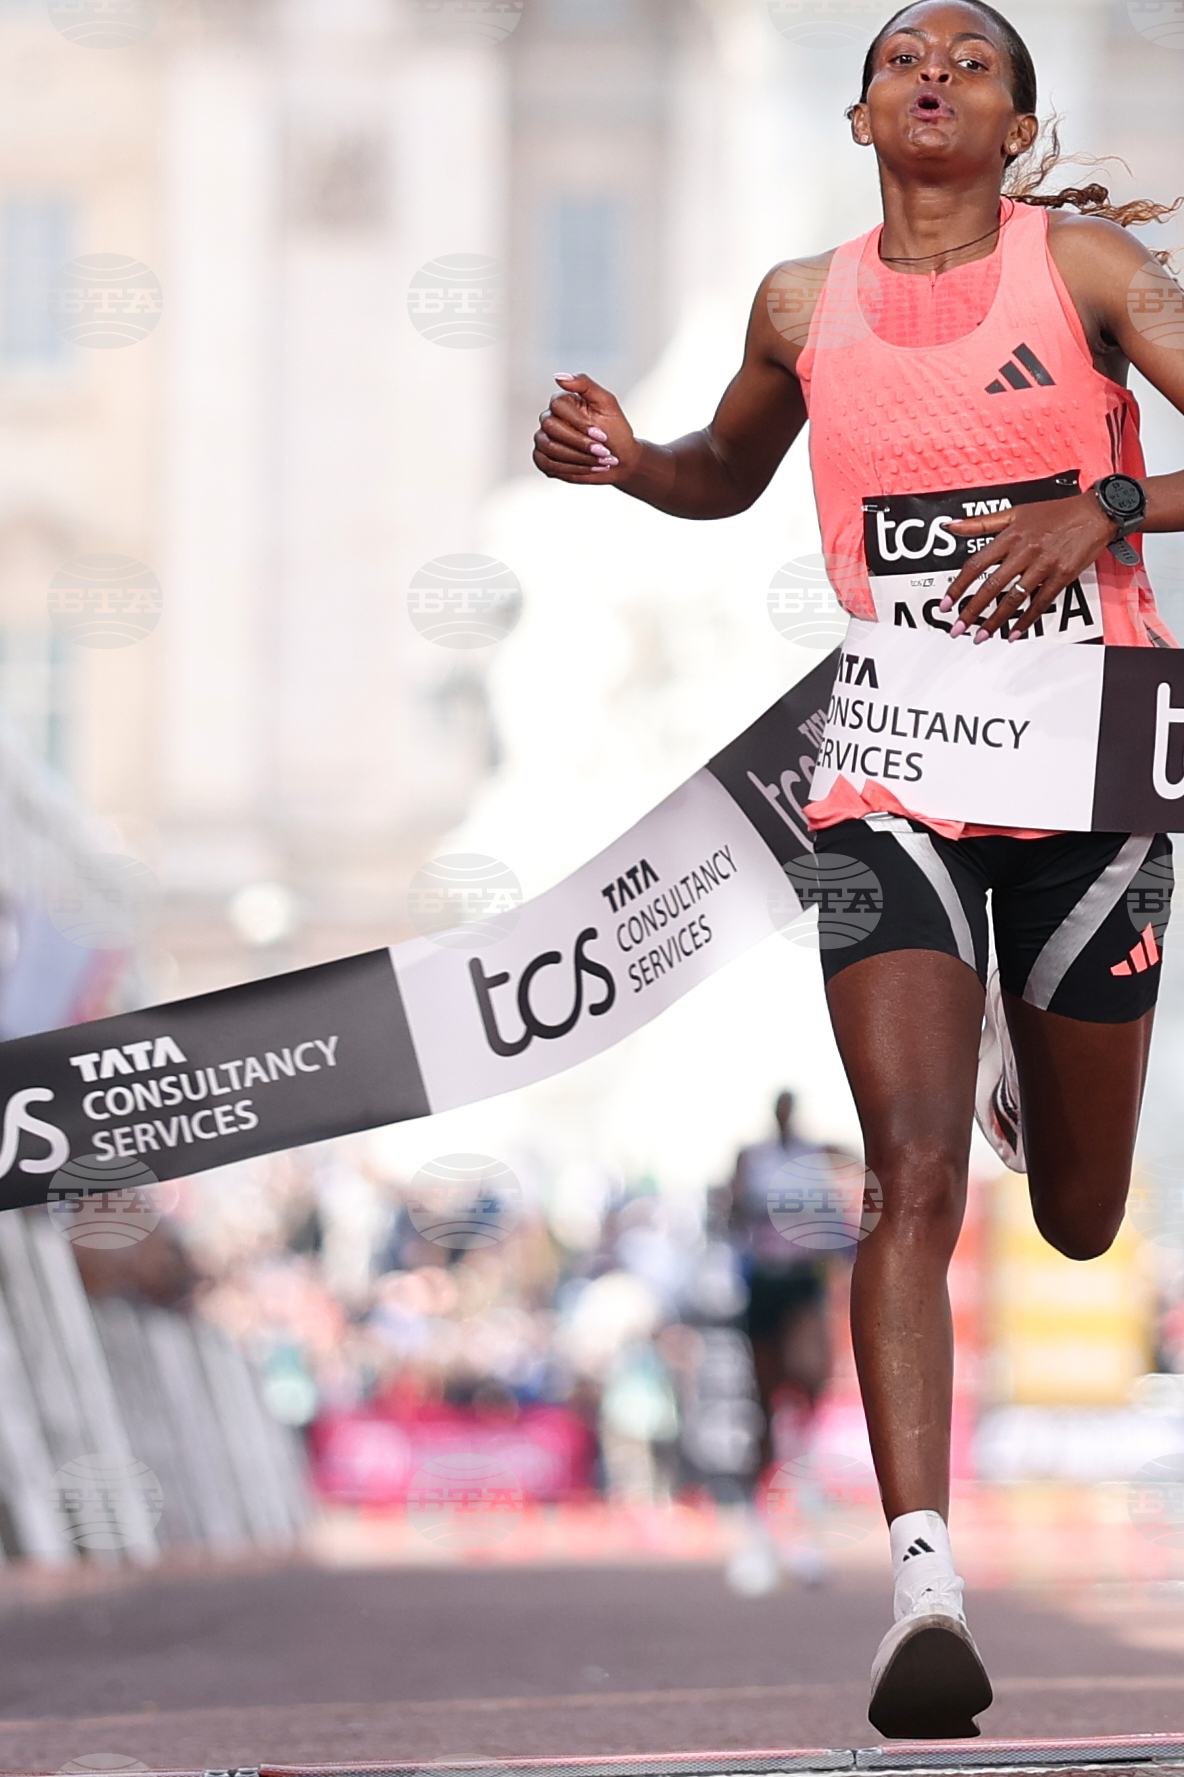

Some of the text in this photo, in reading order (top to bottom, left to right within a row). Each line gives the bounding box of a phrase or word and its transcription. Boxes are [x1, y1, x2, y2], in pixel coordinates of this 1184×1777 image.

[876, 511, 957, 561] tcs
[601, 858, 661, 914] TATA
[616, 844, 739, 953] CONSULTANCY
[628, 914, 713, 994] SERVICES
[468, 926, 617, 1058] tcs
[69, 1036, 188, 1083] TATA
[82, 1035, 339, 1121] CONSULTANCY
[92, 1099, 259, 1162] SERVICES
